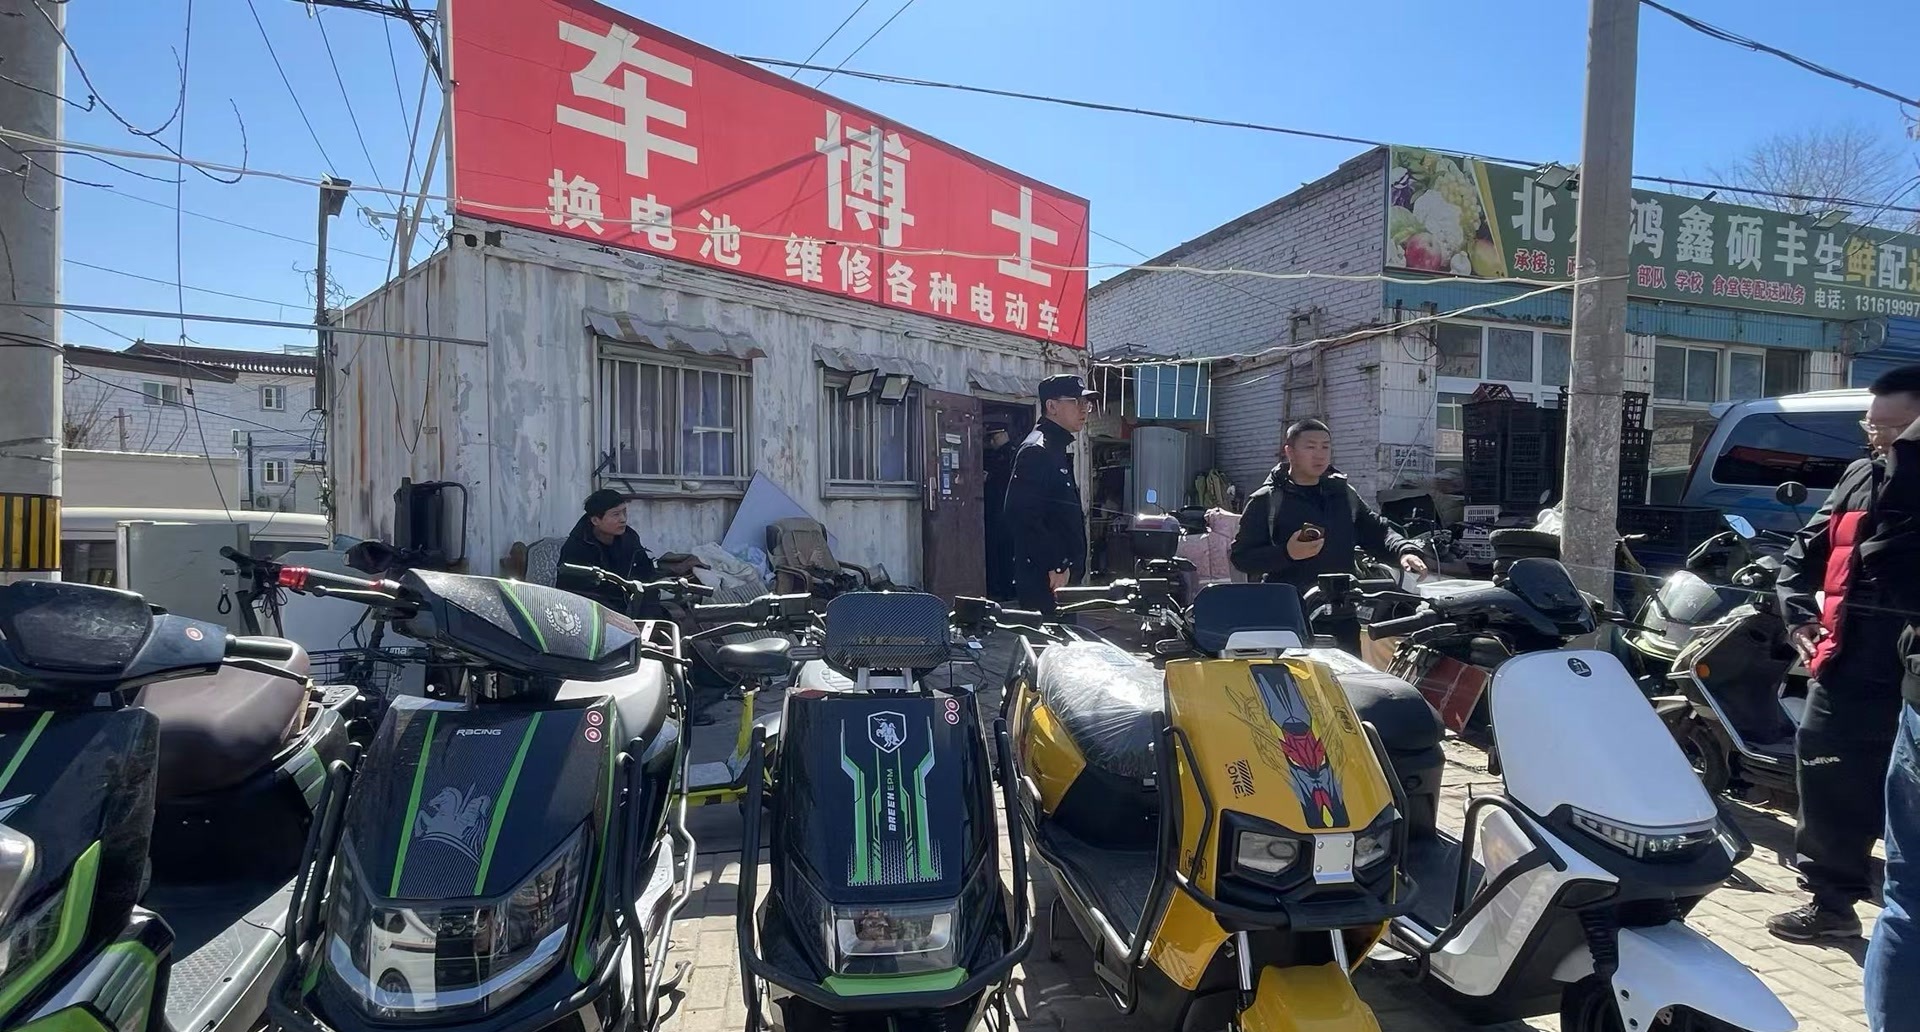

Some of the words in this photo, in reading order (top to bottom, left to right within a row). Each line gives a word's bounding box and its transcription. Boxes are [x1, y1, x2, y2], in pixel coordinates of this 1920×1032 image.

[557, 22, 1059, 287] 车博士
[548, 168, 742, 266] 换电池
[785, 232, 1060, 337] 维修各种电动车
[1637, 264, 1667, 289] 部队
[1675, 269, 1704, 294] 学校
[1712, 274, 1806, 305] 食堂等配送业务
[886, 768, 895, 791] EPM
[1227, 765, 1242, 795] ONE
